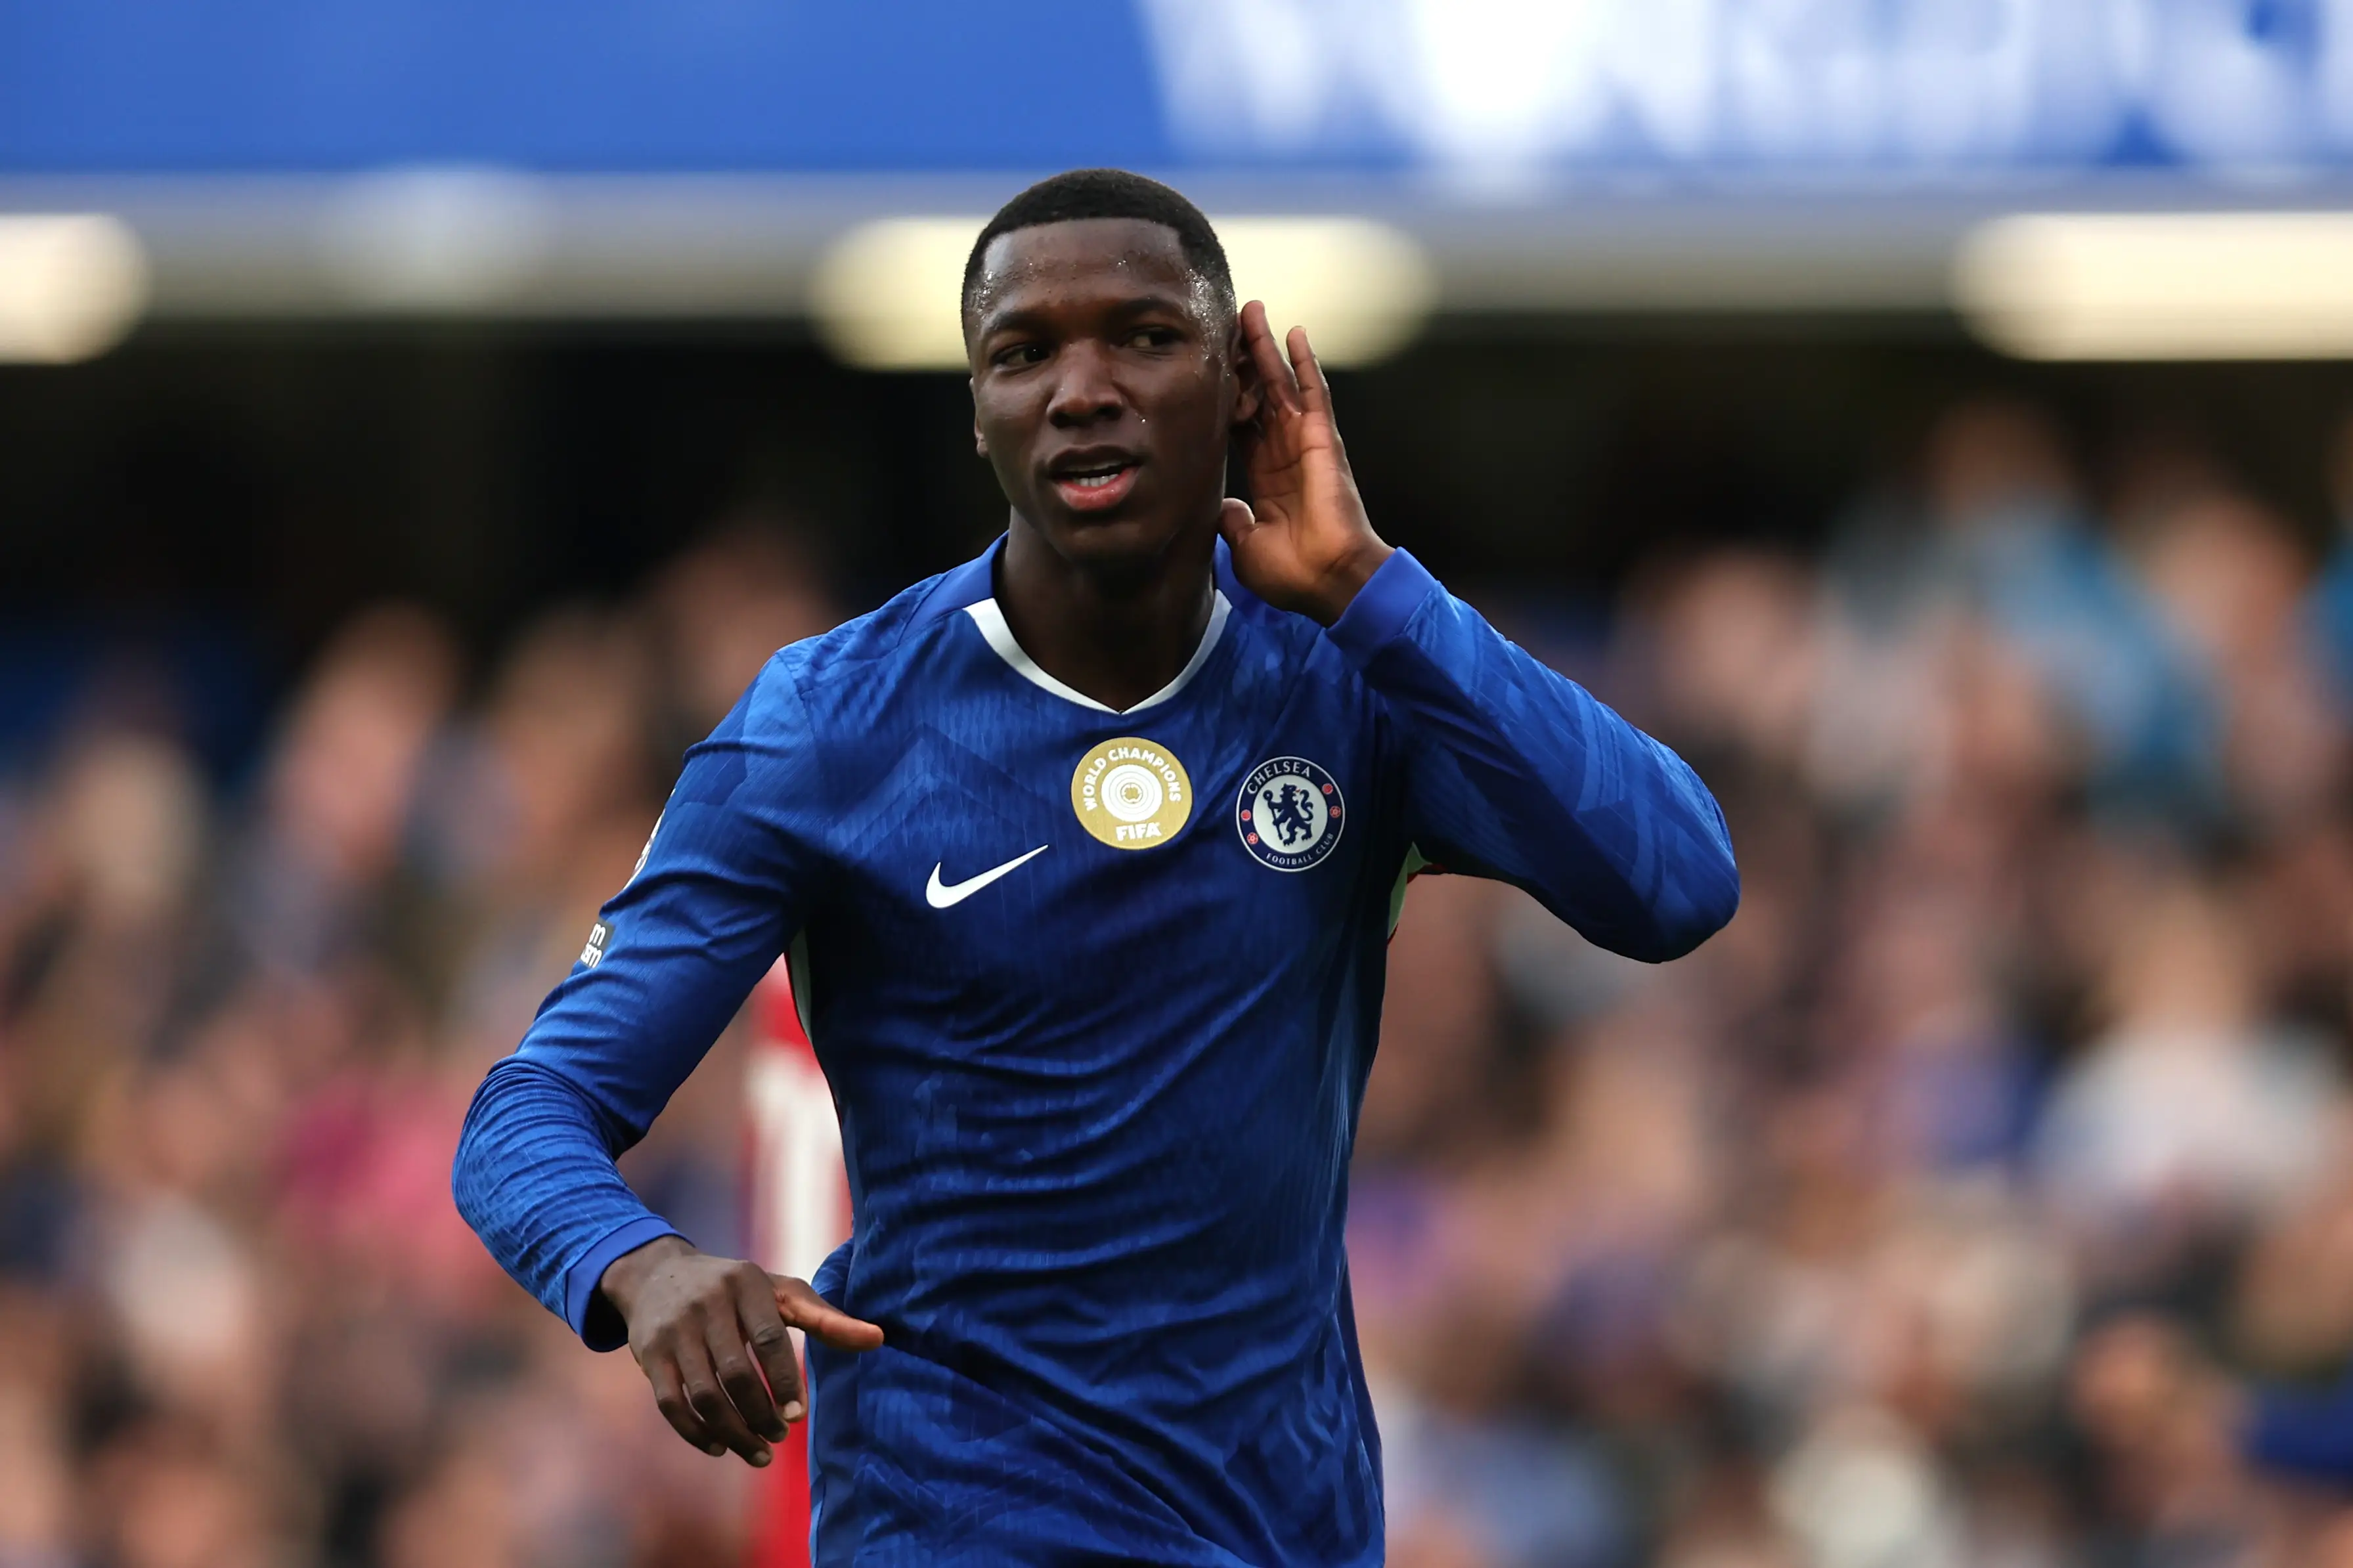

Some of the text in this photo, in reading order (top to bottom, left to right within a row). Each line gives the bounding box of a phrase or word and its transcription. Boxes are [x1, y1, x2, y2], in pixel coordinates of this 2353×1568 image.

[1082, 747, 1181, 811] WORLD CHAMPIONS
[1248, 760, 1311, 795] CHELSEA
[1116, 822, 1162, 841] FIFA
[1266, 833, 1334, 865] FOOTBALL CLUB
